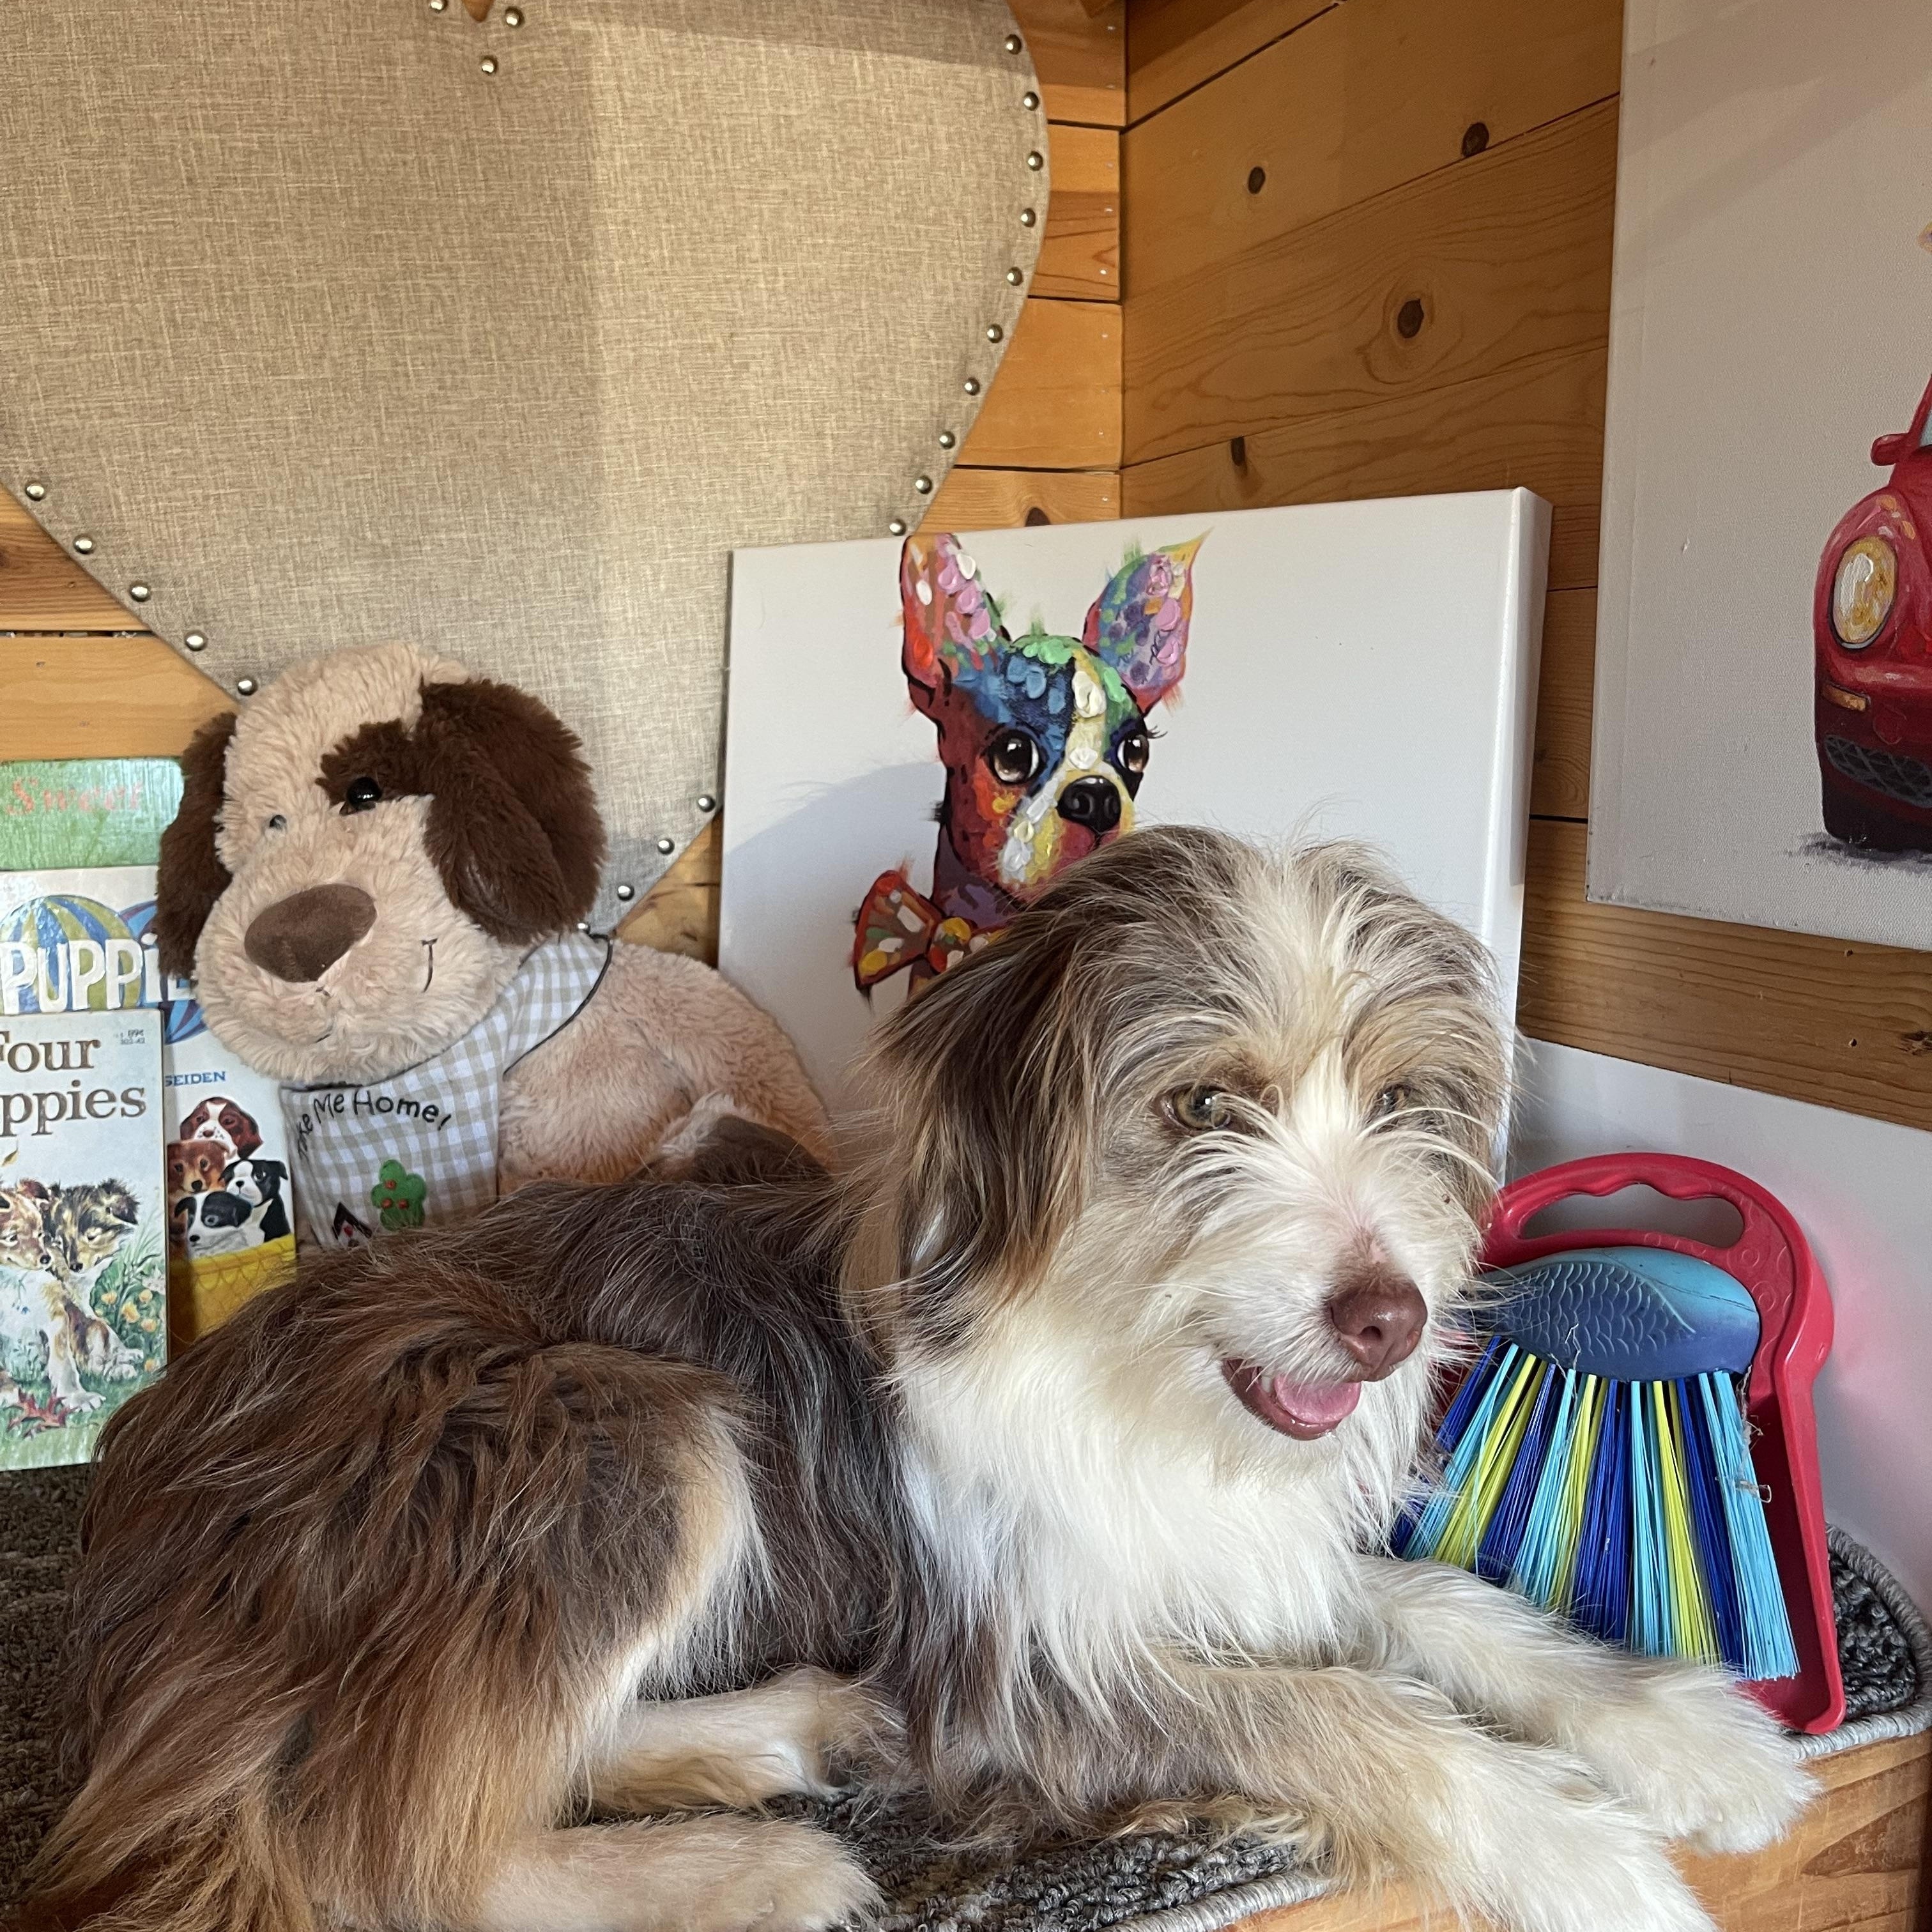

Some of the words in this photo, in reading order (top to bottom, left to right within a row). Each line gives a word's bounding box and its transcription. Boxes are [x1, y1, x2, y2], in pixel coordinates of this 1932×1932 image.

[165, 1071, 226, 1087] SEIDEN
[313, 1093, 345, 1124] Me
[353, 1089, 452, 1131] Home!
